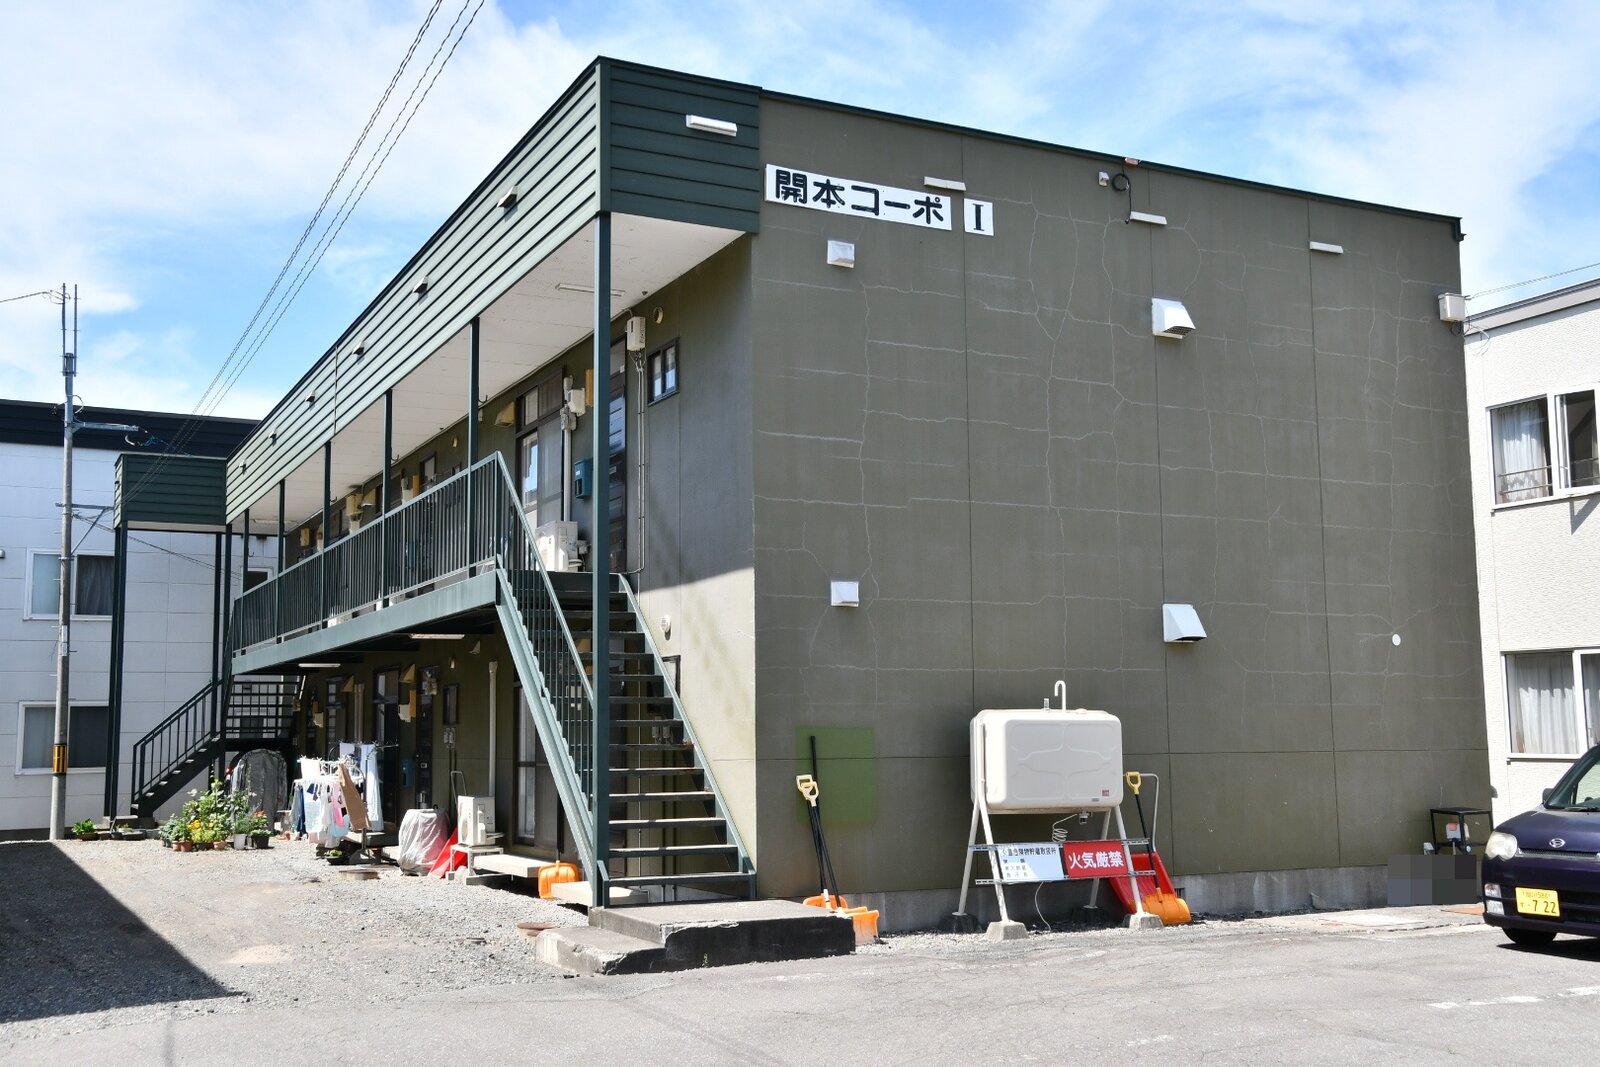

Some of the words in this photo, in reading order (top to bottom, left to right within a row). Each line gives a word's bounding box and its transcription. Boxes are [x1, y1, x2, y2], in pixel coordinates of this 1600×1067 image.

[775, 169, 944, 224] 開本コーポ
[1068, 850, 1124, 870] 火気厳禁
